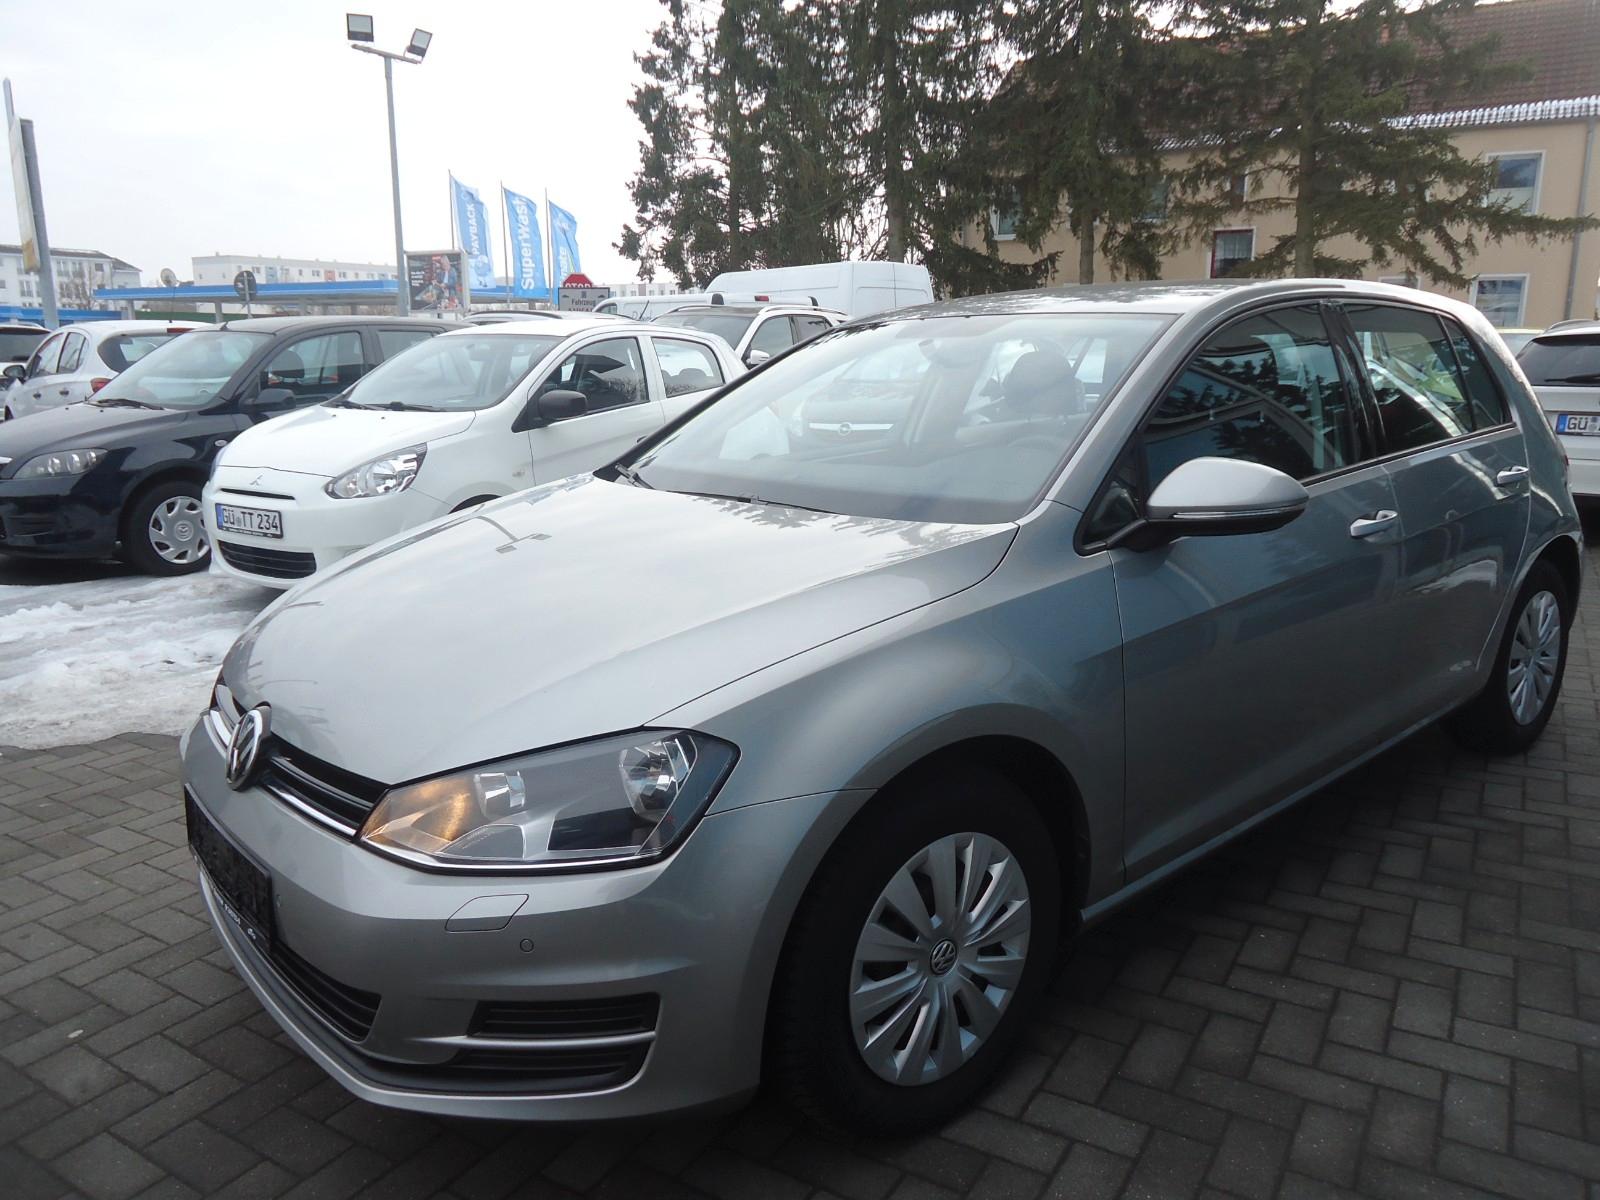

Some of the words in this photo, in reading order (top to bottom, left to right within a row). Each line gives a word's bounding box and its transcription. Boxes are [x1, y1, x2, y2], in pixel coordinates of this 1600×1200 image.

[467, 203, 480, 255] PAYBACK
[1567, 416, 1588, 430] GÜ
[222, 508, 235, 525] GÜ
[240, 511, 254, 528] TT
[257, 513, 278, 531] 234
